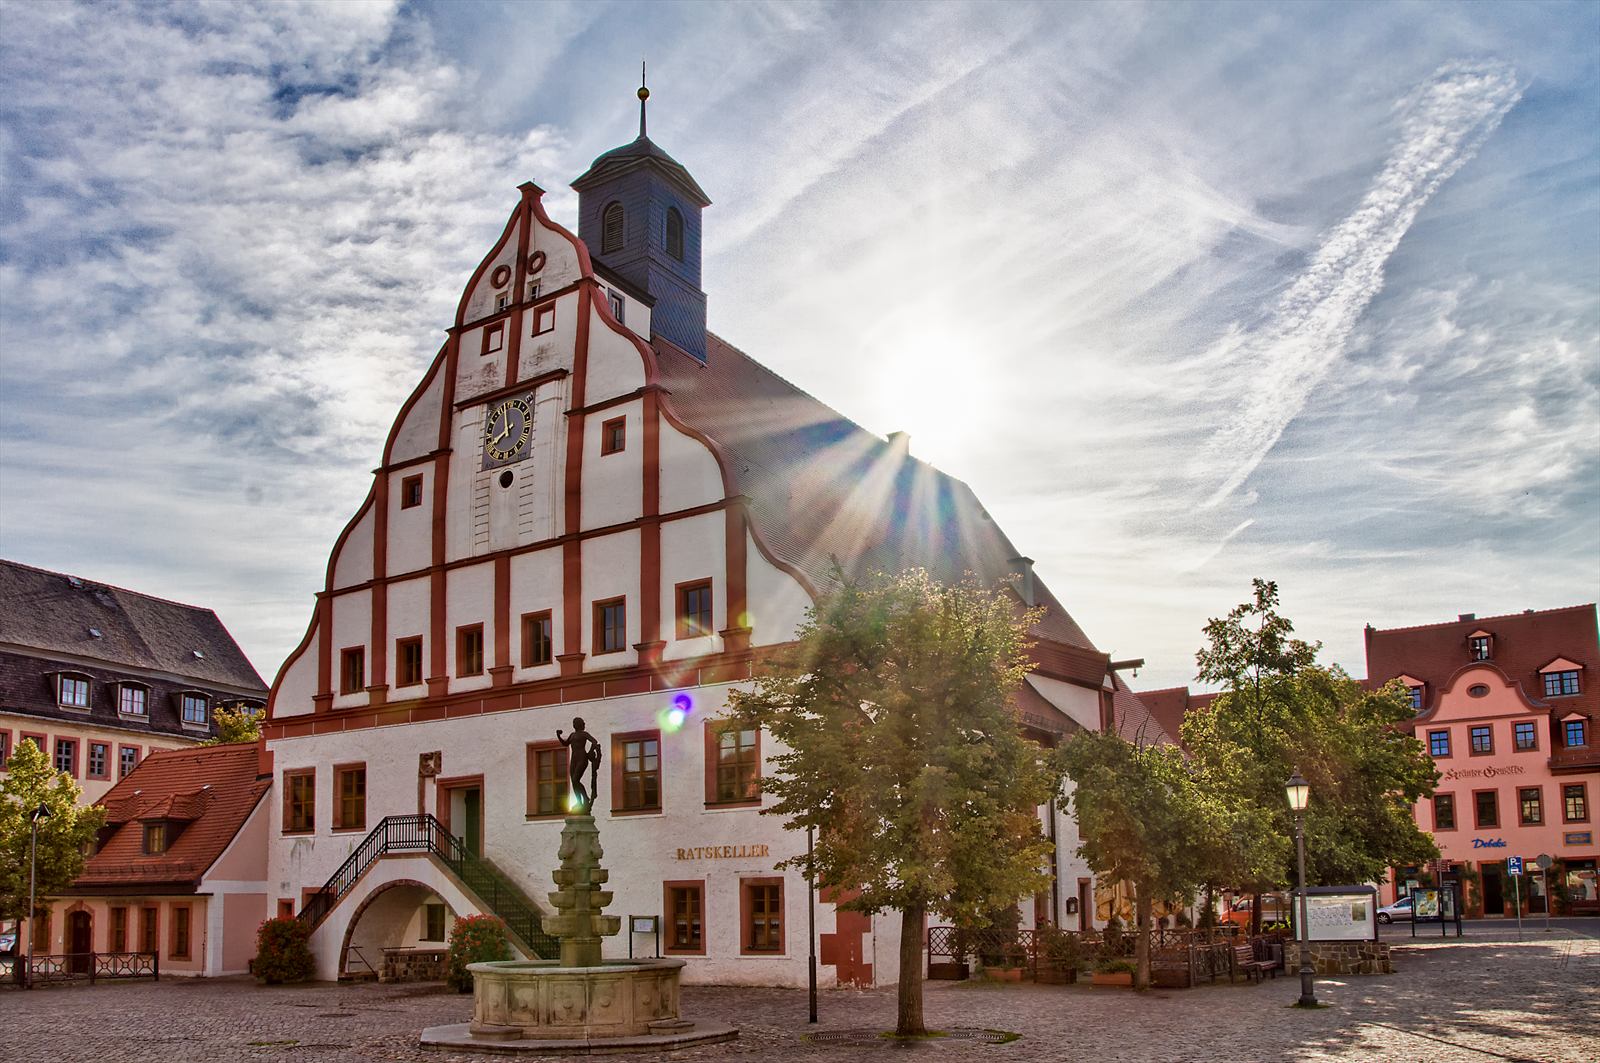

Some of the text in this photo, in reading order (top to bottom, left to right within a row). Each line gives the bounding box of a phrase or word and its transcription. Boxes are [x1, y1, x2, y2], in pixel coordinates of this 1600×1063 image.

[1471, 837, 1507, 849] Debeka
[676, 844, 770, 861] RATSKELLER
[1509, 857, 1517, 866] P
